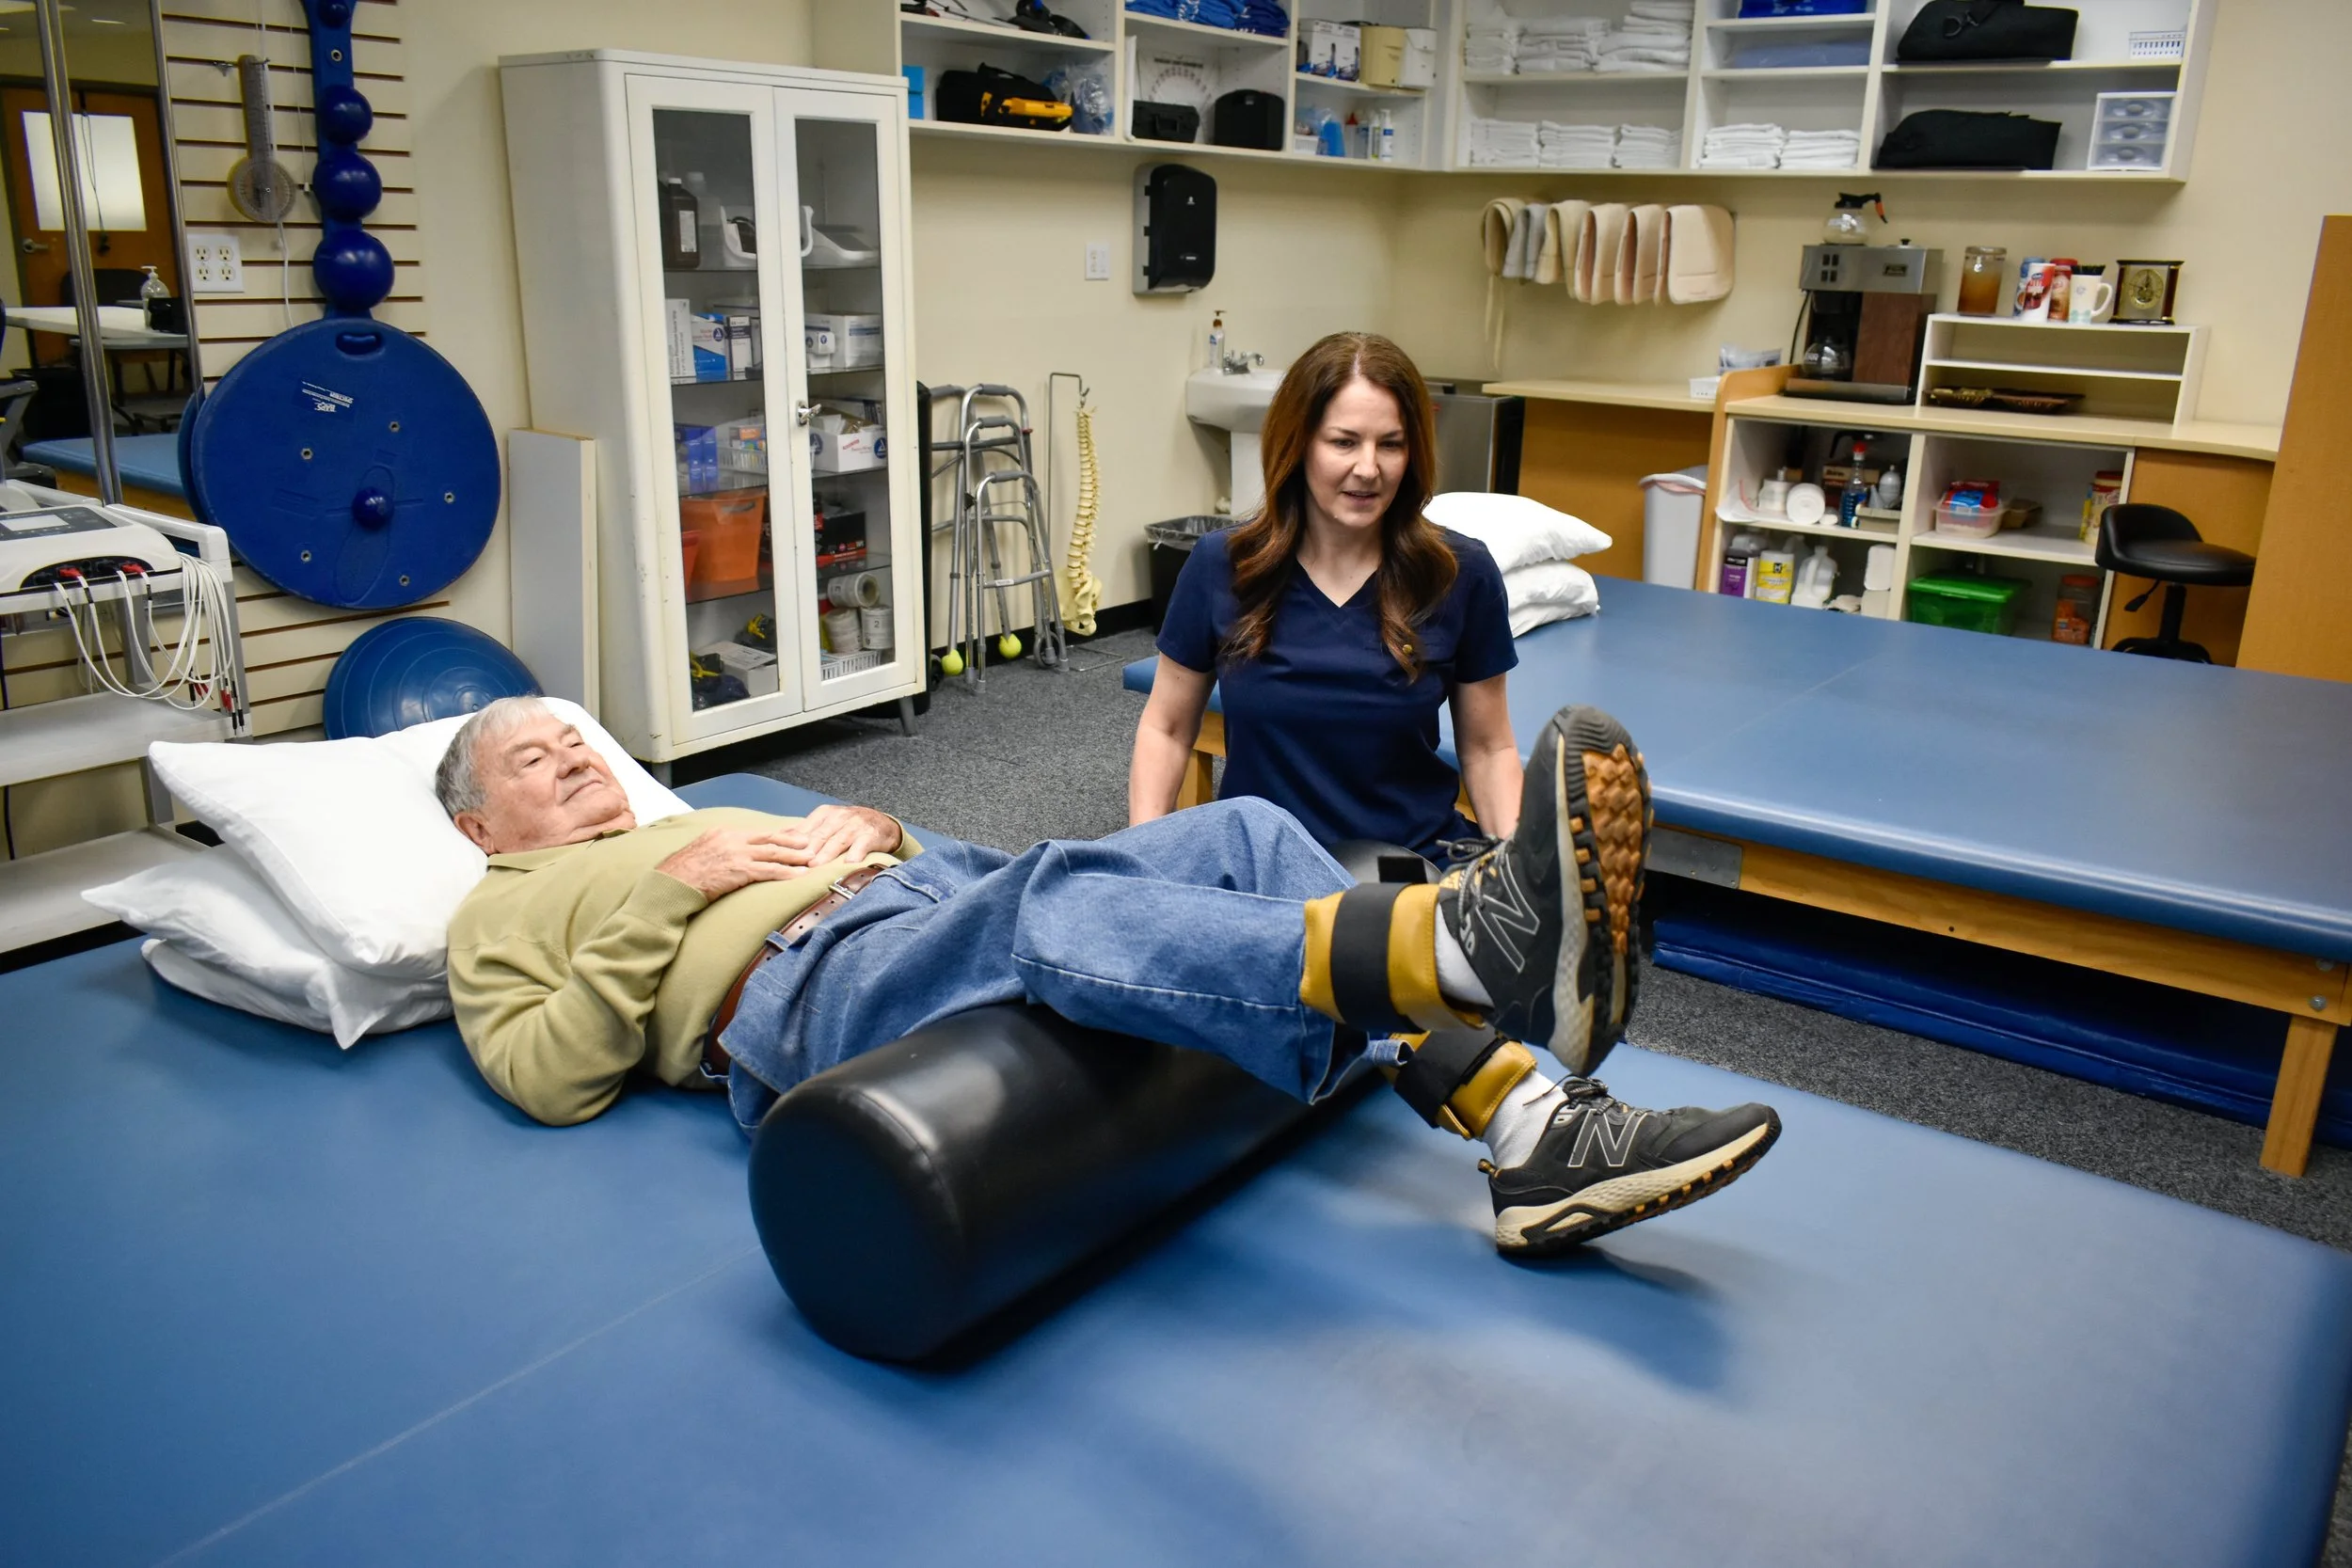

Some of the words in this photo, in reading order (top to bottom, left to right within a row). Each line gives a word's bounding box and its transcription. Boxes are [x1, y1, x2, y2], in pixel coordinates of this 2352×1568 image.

[874, 620, 880, 628] 2
[1475, 852, 1540, 974] N
[1567, 1108, 1648, 1167] N
